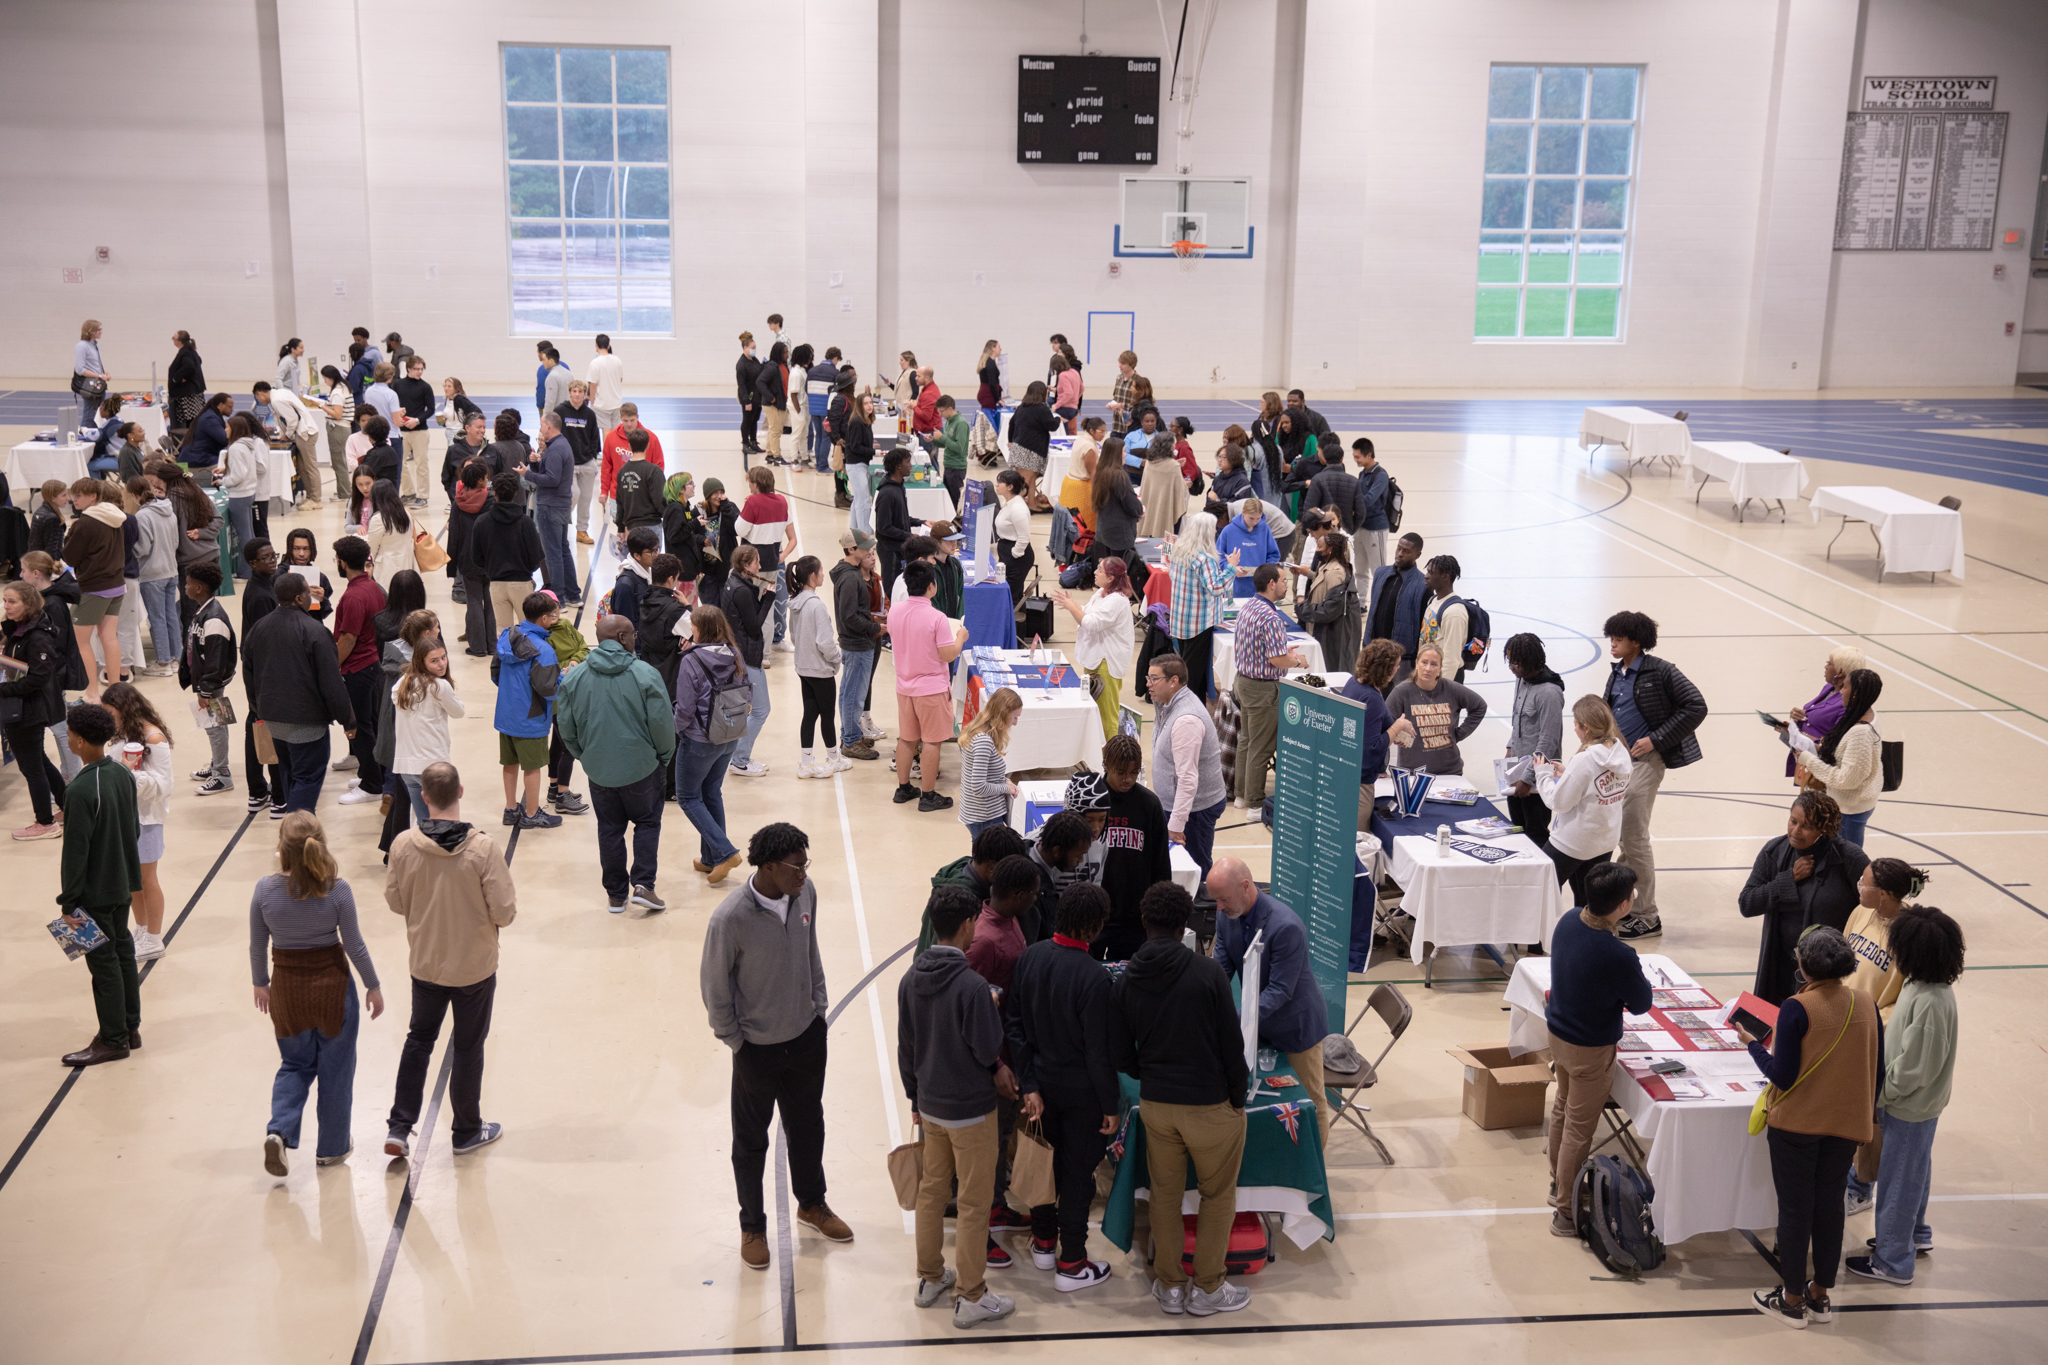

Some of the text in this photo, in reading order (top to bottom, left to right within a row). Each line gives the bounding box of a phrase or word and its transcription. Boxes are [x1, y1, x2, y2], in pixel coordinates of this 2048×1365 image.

[1023, 58, 1054, 70] Westtown
[1128, 60, 1156, 72] Guests
[1870, 80, 1992, 90] WESTTOWN
[1887, 90, 1969, 100] SCHOOL
[1076, 96, 1103, 108] period
[1024, 112, 1044, 122] fouls
[1076, 112, 1102, 125] player
[1134, 114, 1154, 124] fouls
[1026, 151, 1042, 159] won
[1078, 152, 1098, 162] game
[1136, 152, 1152, 160] won
[1411, 703, 1451, 716] PUMPKIN SPICE
[1304, 706, 1336, 726] University
[1416, 714, 1451, 727] FLANNELS
[1303, 718, 1332, 733] of Exeter
[1282, 736, 1310, 750] Subject Areas:
[1422, 735, 1452, 748] S'MORES
[1616, 780, 1626, 789] SHO
[1389, 765, 1436, 818] V
[1107, 826, 1144, 852] FFINS
